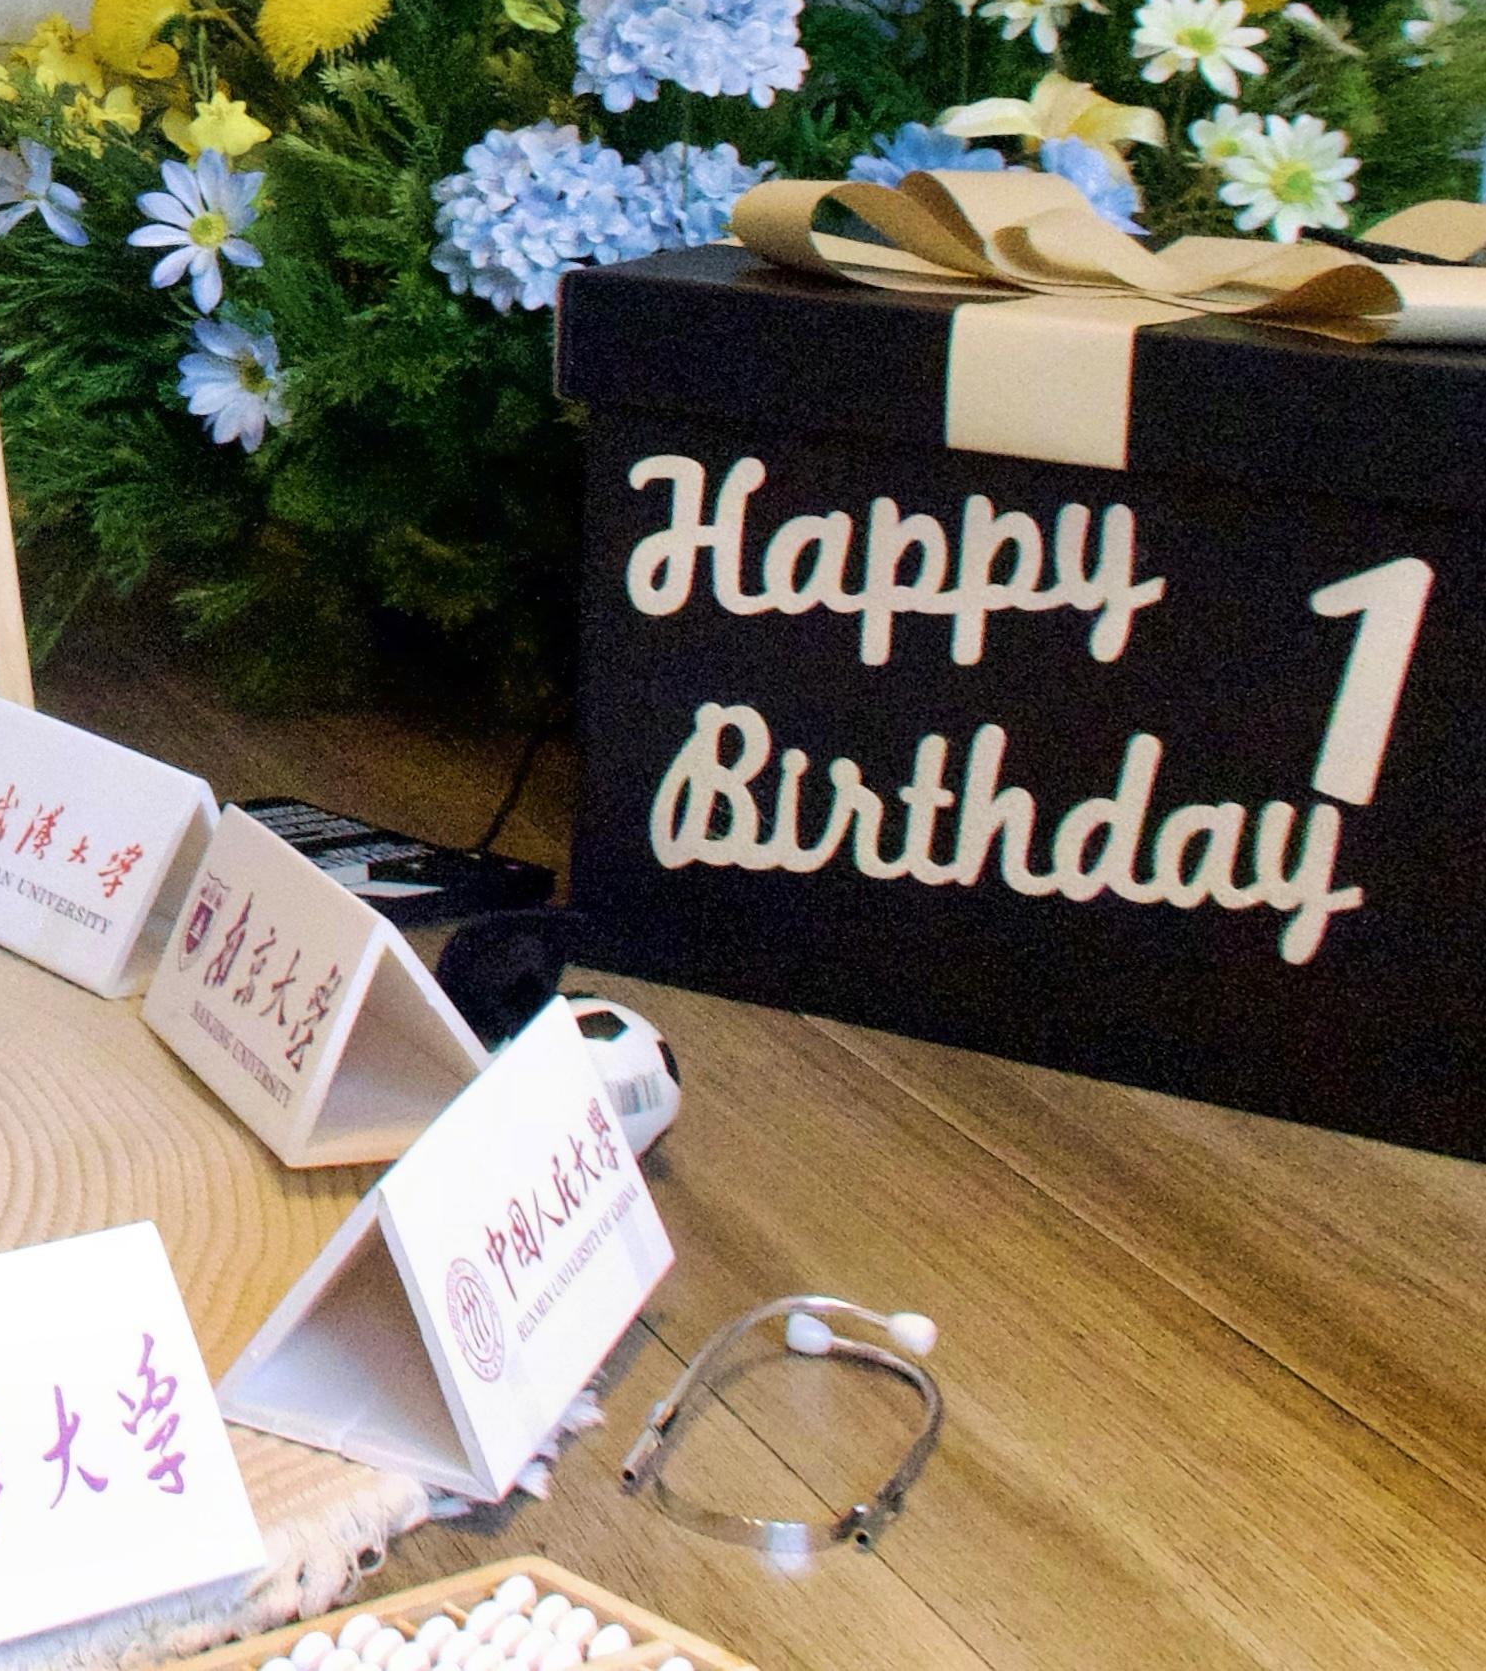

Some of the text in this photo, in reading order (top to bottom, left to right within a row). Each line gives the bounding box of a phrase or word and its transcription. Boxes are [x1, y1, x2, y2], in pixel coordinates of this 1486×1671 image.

[628, 454, 1166, 666] Happy
[1309, 557, 1434, 806] 1
[16, 878, 113, 935] UNIVERSITY
[649, 702, 1363, 965] Birthday
